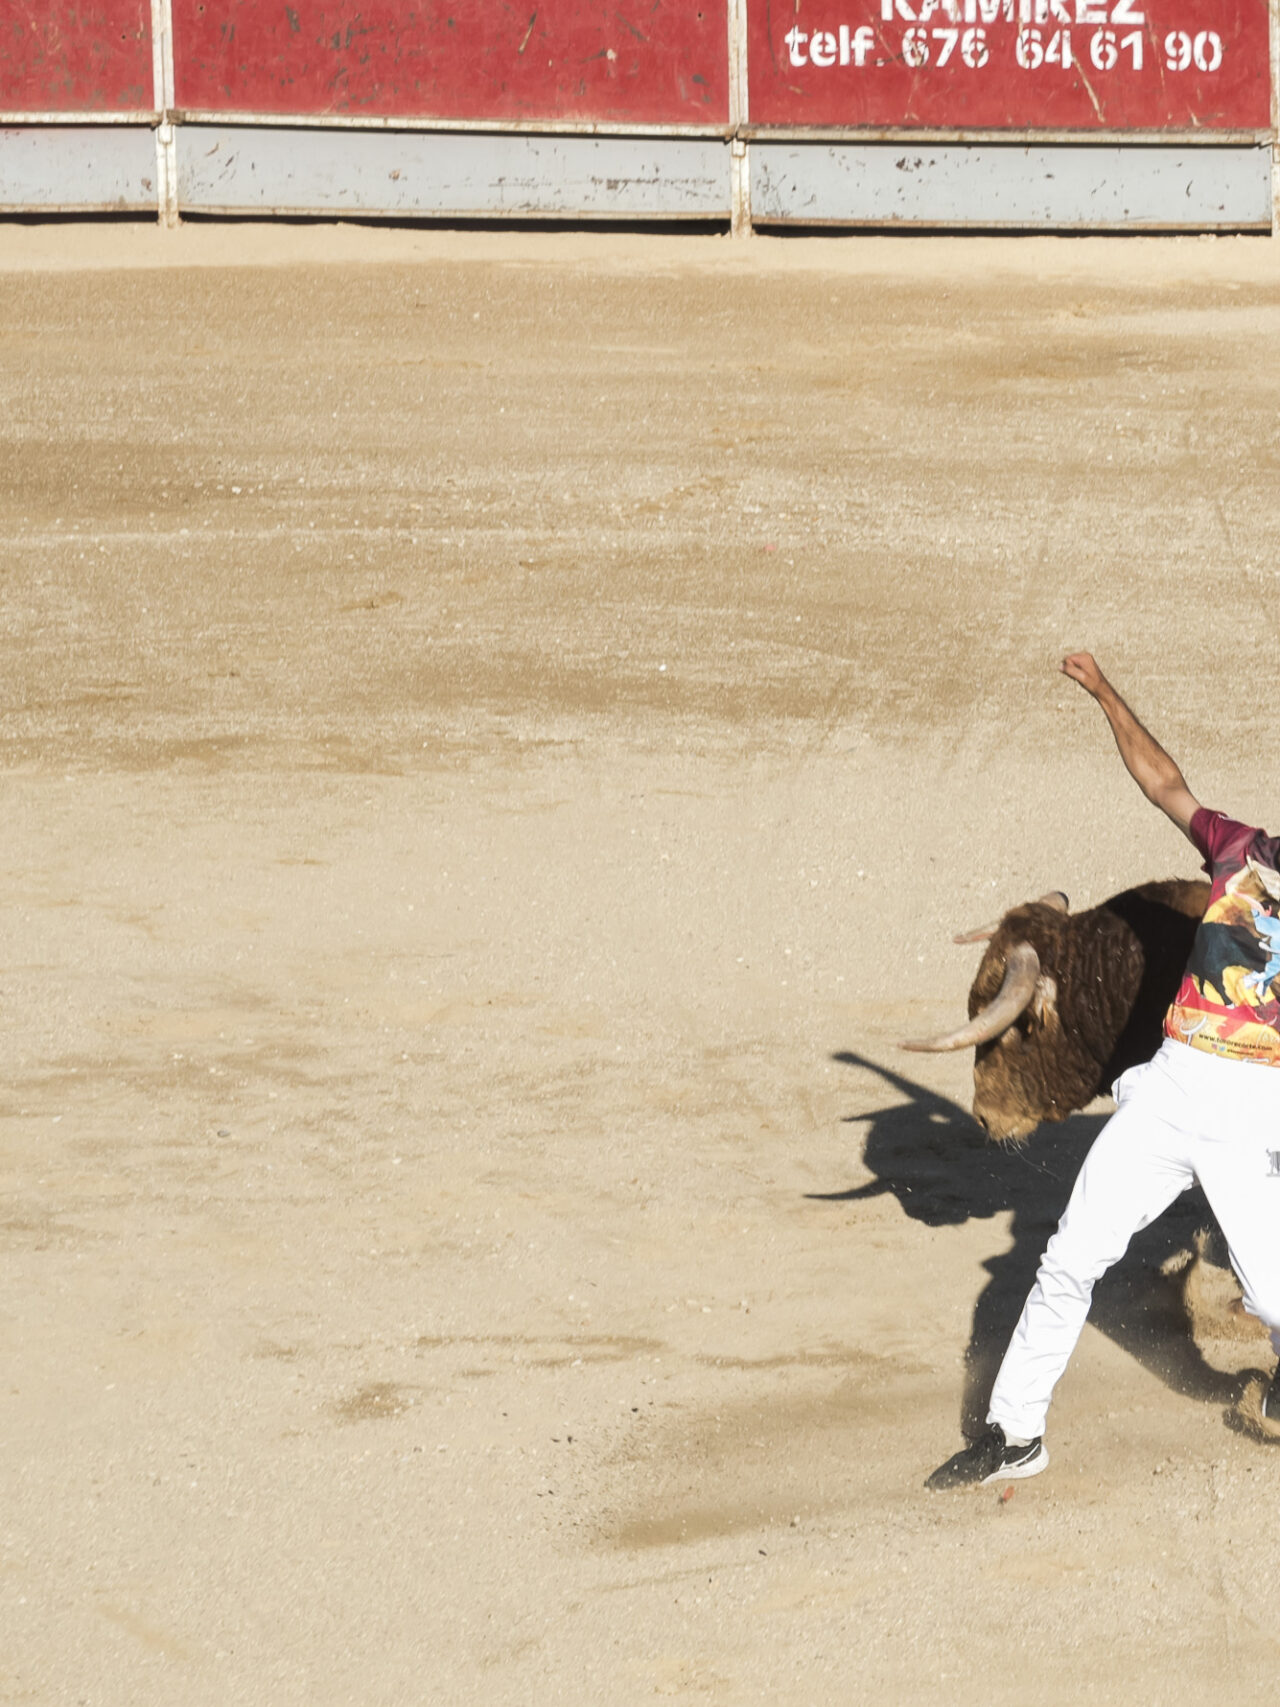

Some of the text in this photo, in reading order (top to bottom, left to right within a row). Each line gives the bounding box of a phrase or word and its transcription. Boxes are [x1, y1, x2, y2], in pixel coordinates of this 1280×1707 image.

[900, 27, 989, 68] 676
[1015, 30, 1077, 70] 64
[1090, 30, 1143, 71] 61
[1164, 31, 1223, 72] 90
